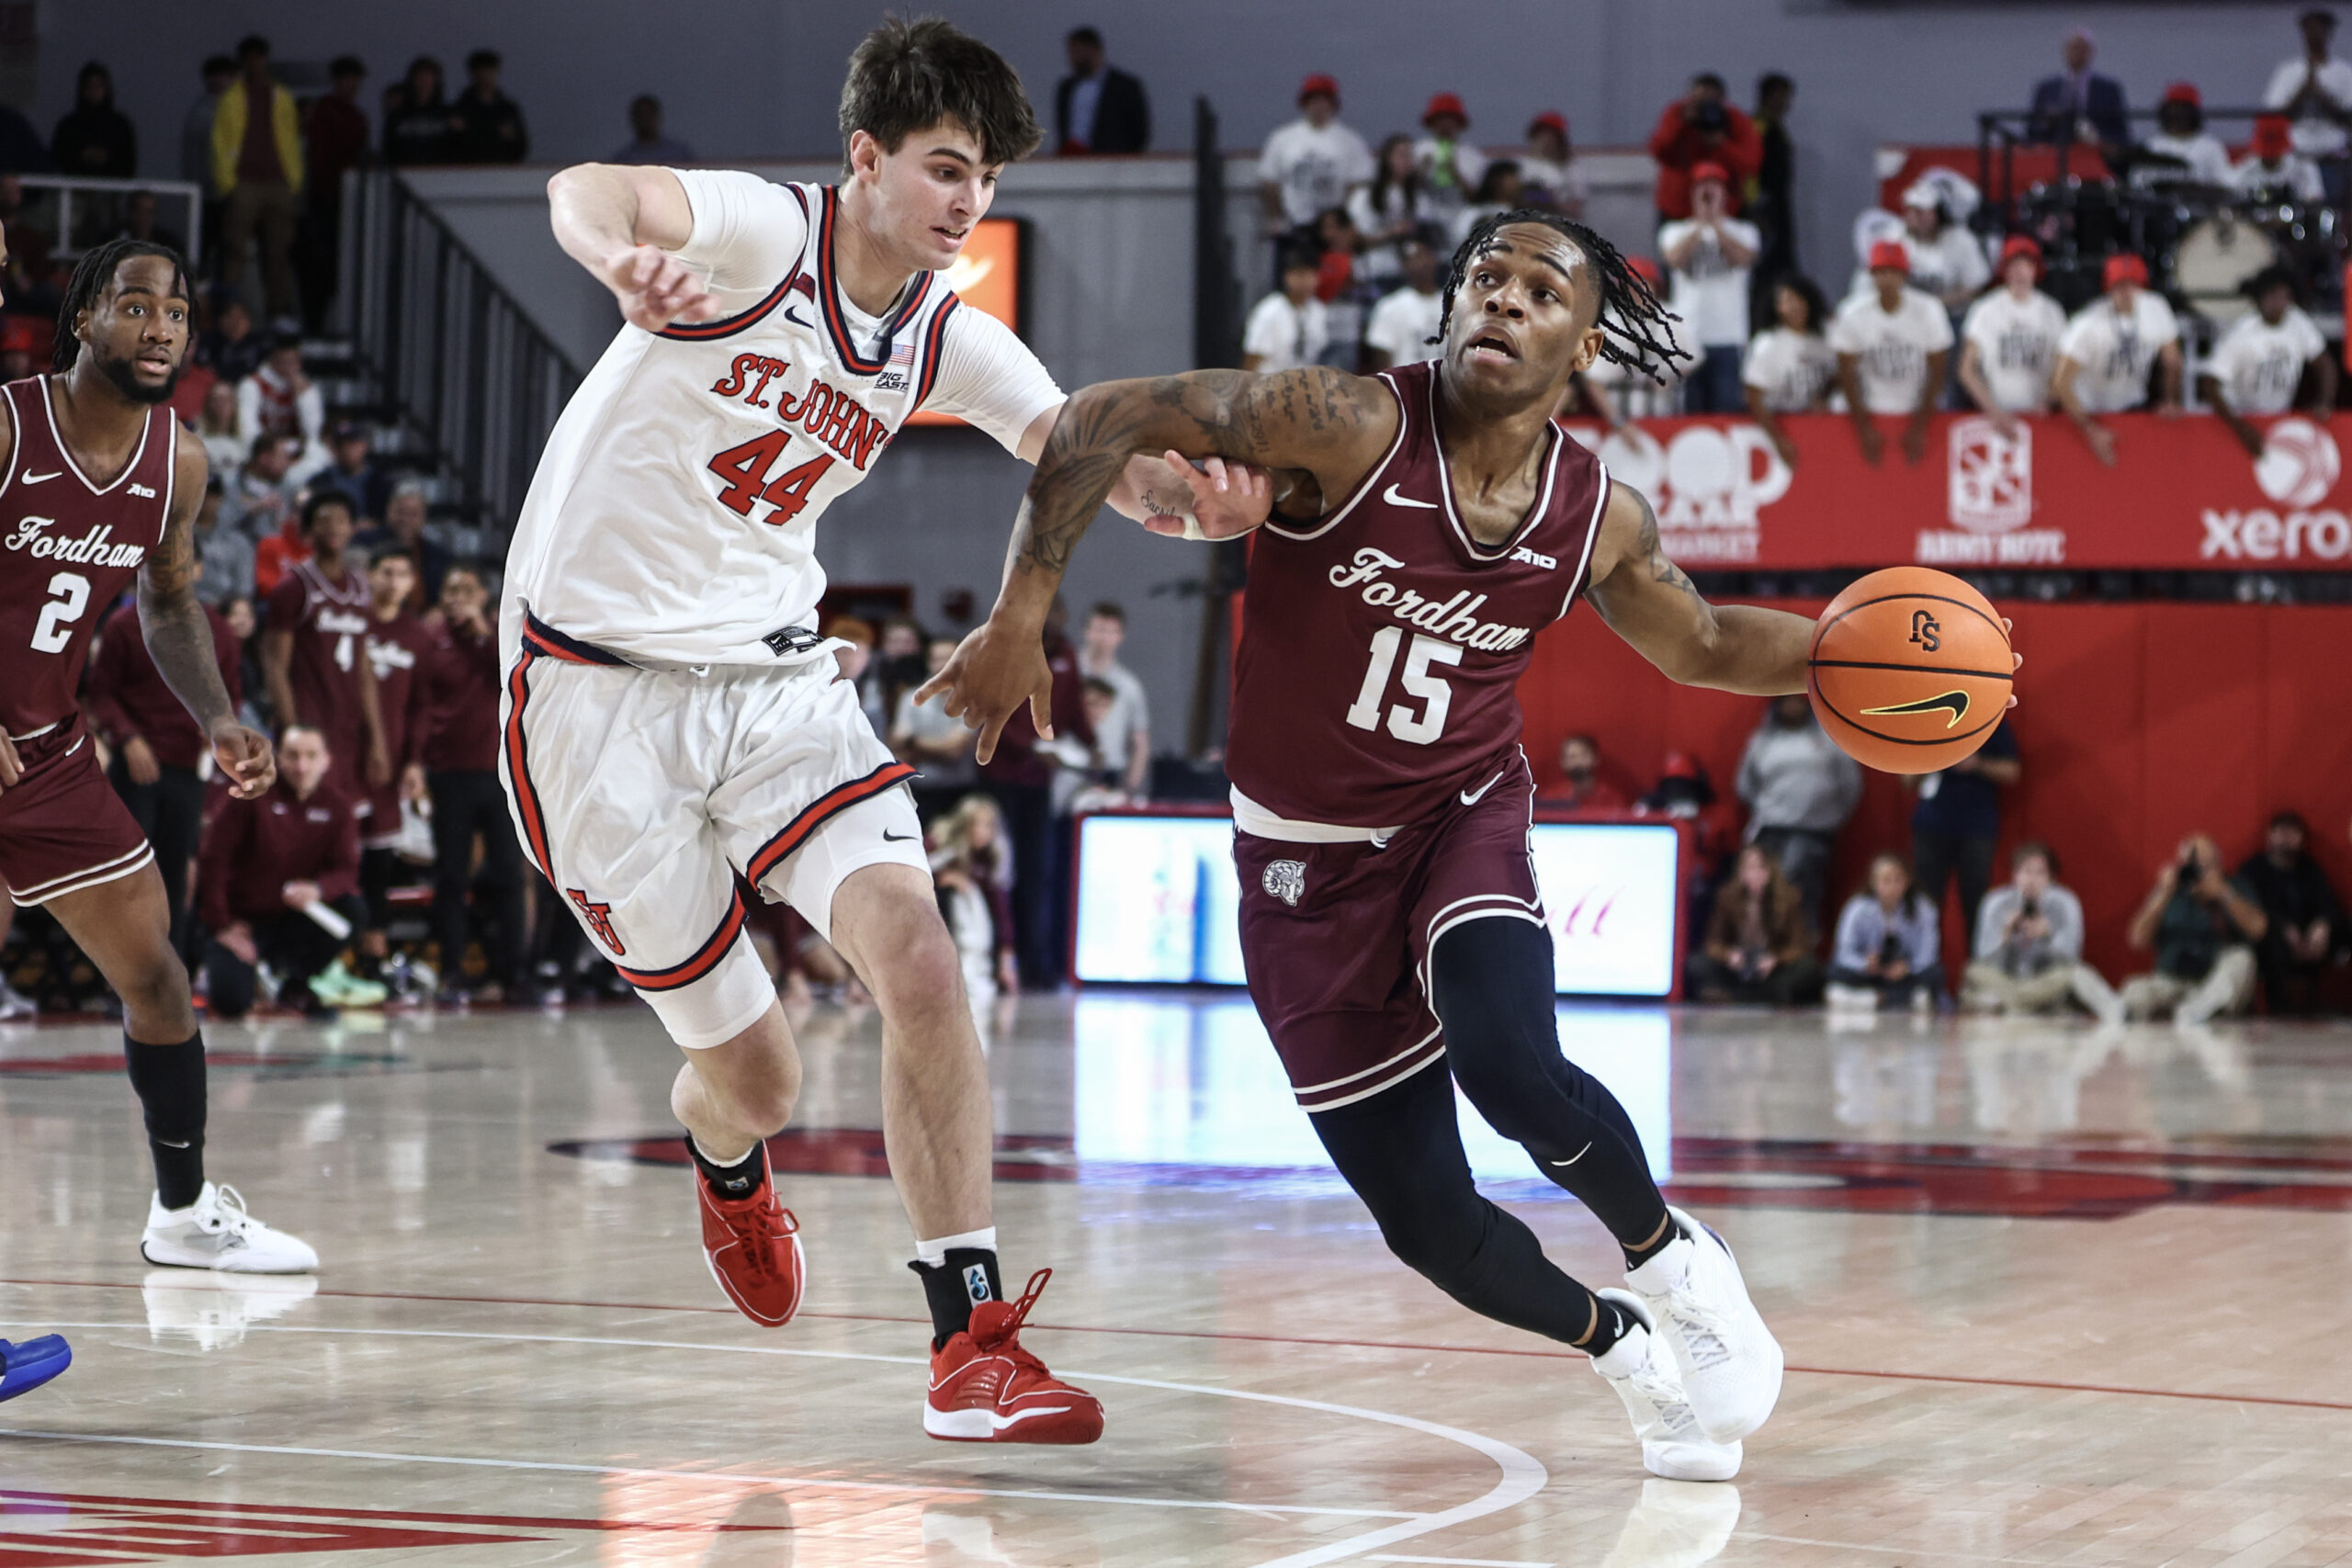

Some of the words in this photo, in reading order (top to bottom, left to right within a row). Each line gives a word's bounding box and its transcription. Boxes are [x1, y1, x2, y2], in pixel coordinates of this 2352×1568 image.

[709, 353, 790, 408] ST.
[777, 378, 896, 470] JOHN'
[126, 483, 156, 499] A10
[707, 428, 836, 526] 44
[5, 515, 145, 569] Fordham
[1510, 546, 1557, 570] A10
[2199, 508, 2352, 560] xero
[30, 571, 91, 654] 2
[1329, 547, 1530, 651] Fordham
[1346, 626, 1464, 745] 15
